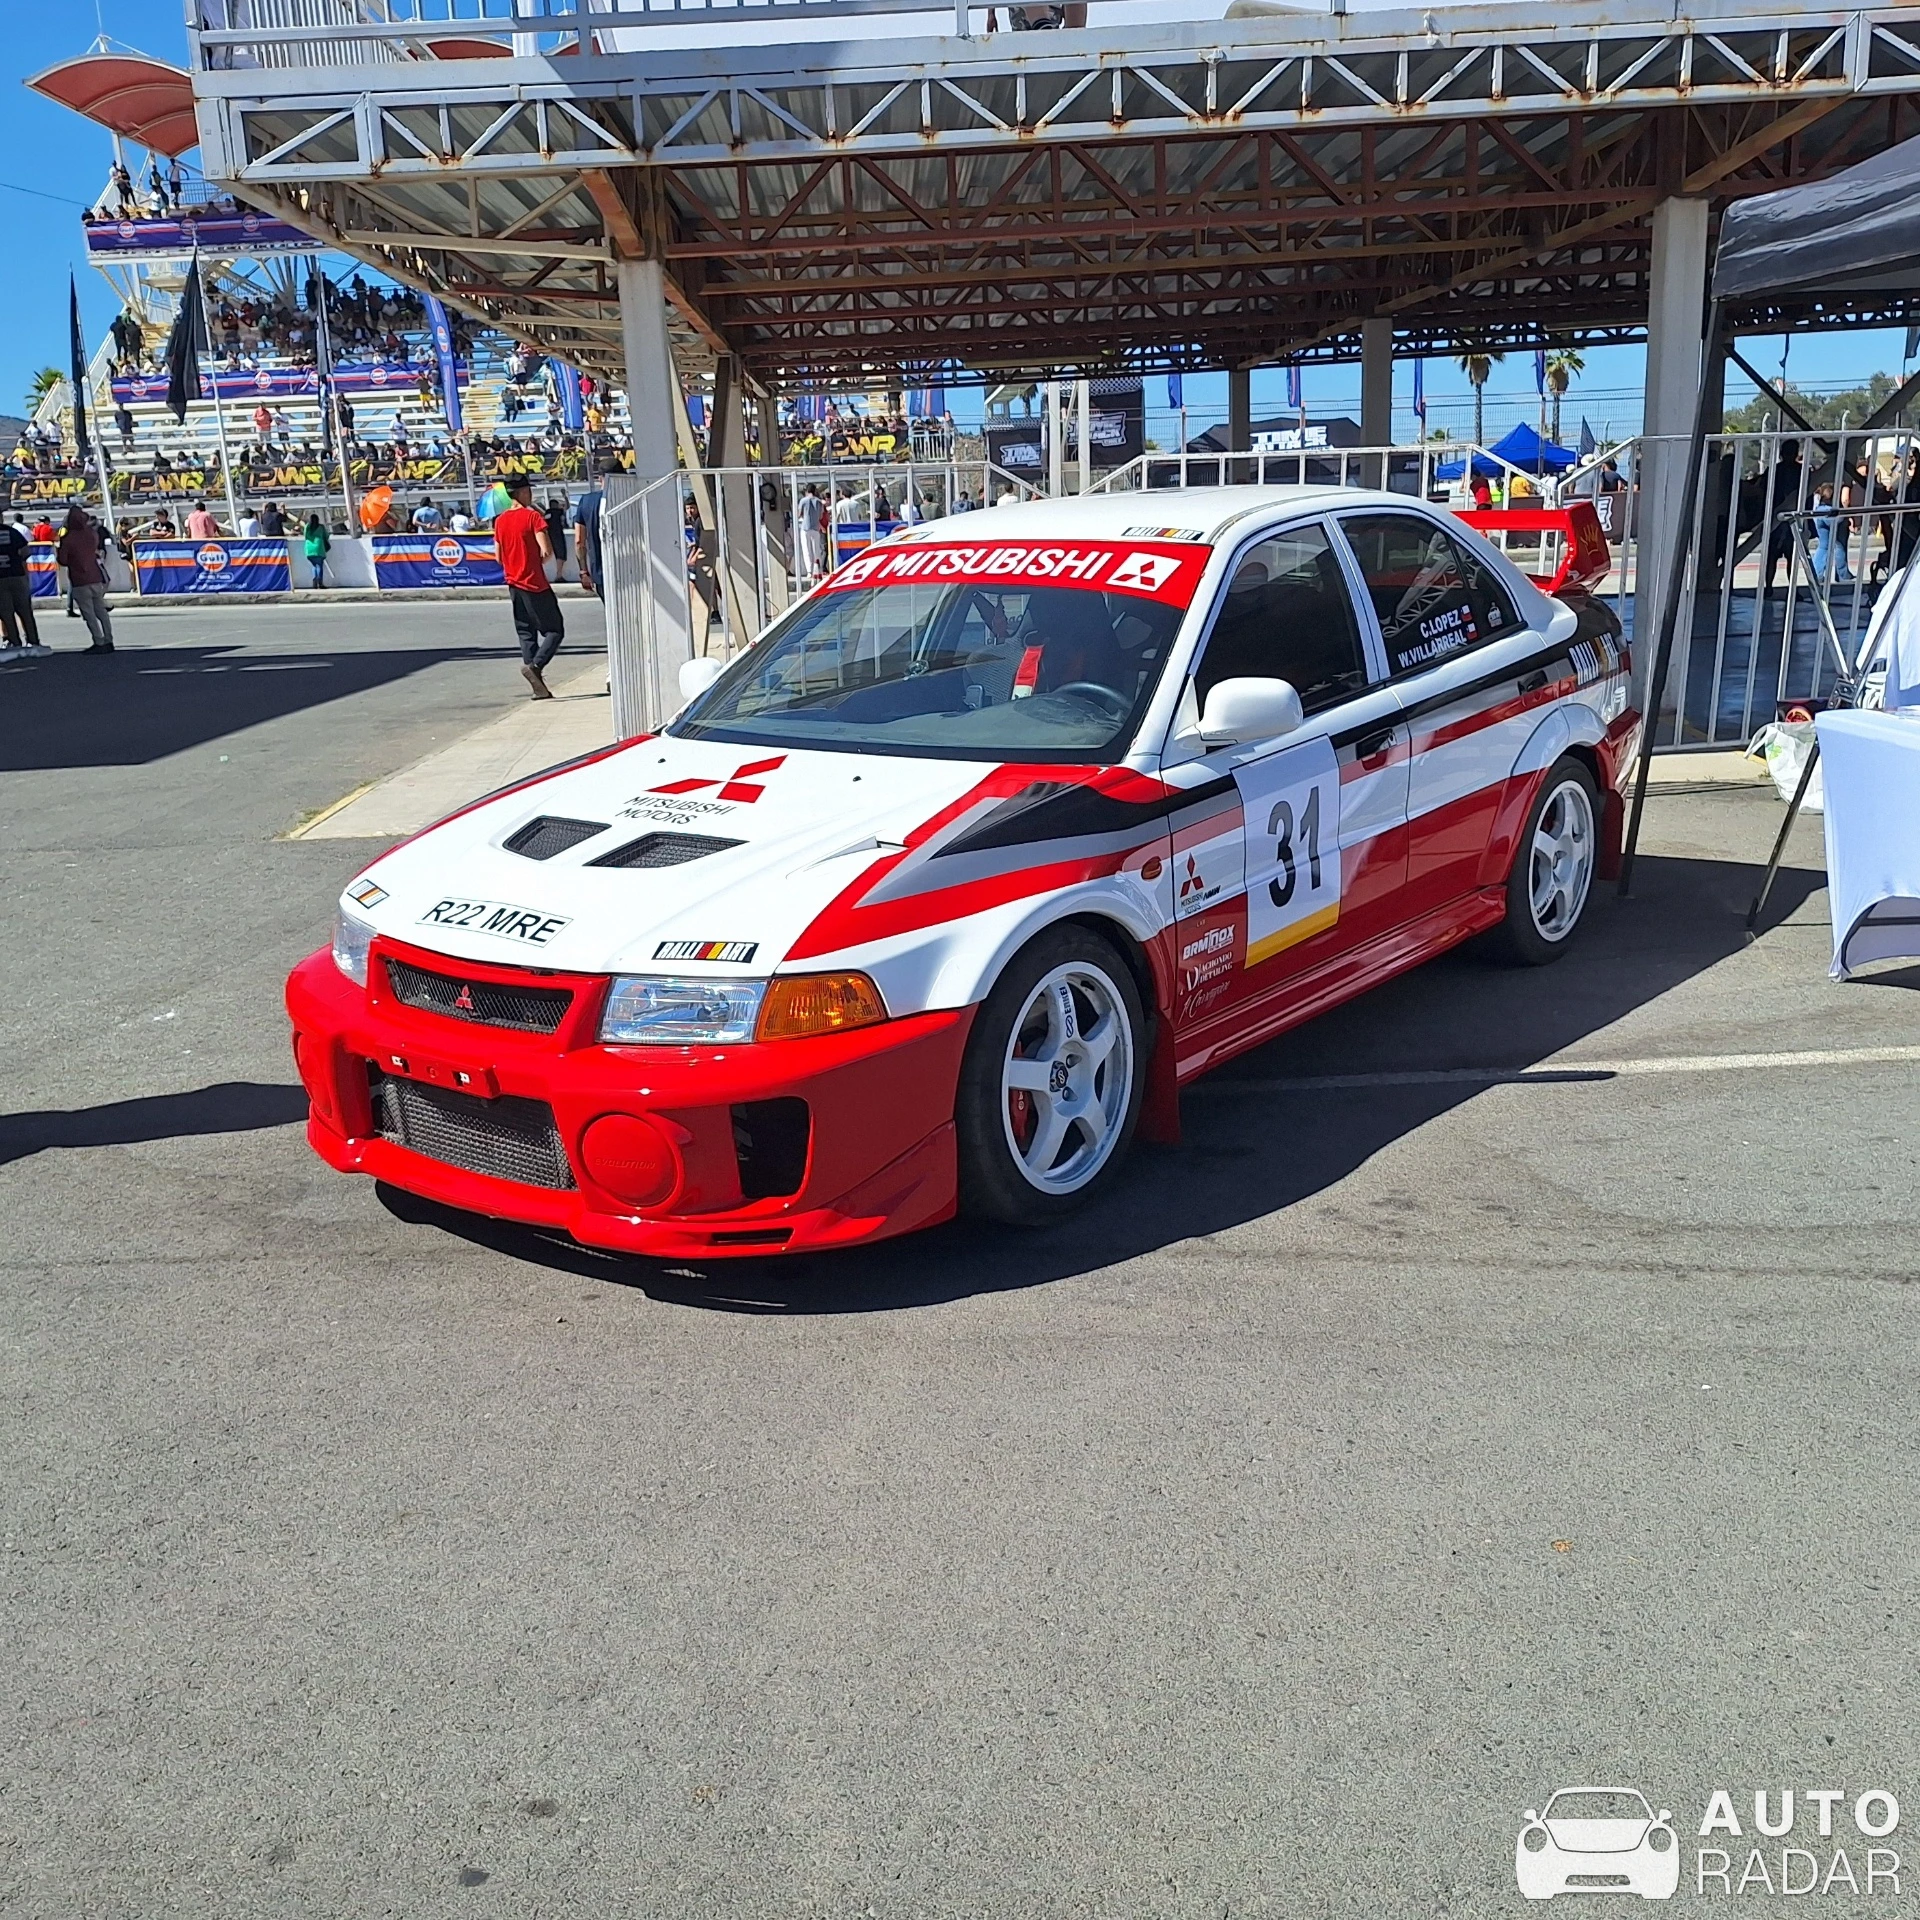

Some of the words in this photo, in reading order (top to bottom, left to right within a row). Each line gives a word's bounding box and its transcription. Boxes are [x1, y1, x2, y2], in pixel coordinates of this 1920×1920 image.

[824, 434, 896, 457] PWR
[1250, 425, 1328, 444] TIME
[250, 465, 324, 487] PWR
[369, 460, 443, 482] PWR
[11, 477, 86, 500] PWR
[199, 552, 225, 563] Gulf
[436, 548, 461, 557] Gulf
[878, 548, 1113, 581] MITSUBISHI
[1420, 608, 1462, 639] C.LOPEZ
[1398, 628, 1468, 669] W.VILLARREAL
[615, 807, 698, 825] MOTORS
[624, 796, 737, 816] MITSUBISHI
[1267, 785, 1321, 908] 31
[421, 900, 486, 926] R22
[480, 907, 566, 943] MRE
[655, 942, 705, 960] RALLI
[716, 942, 756, 962] ART
